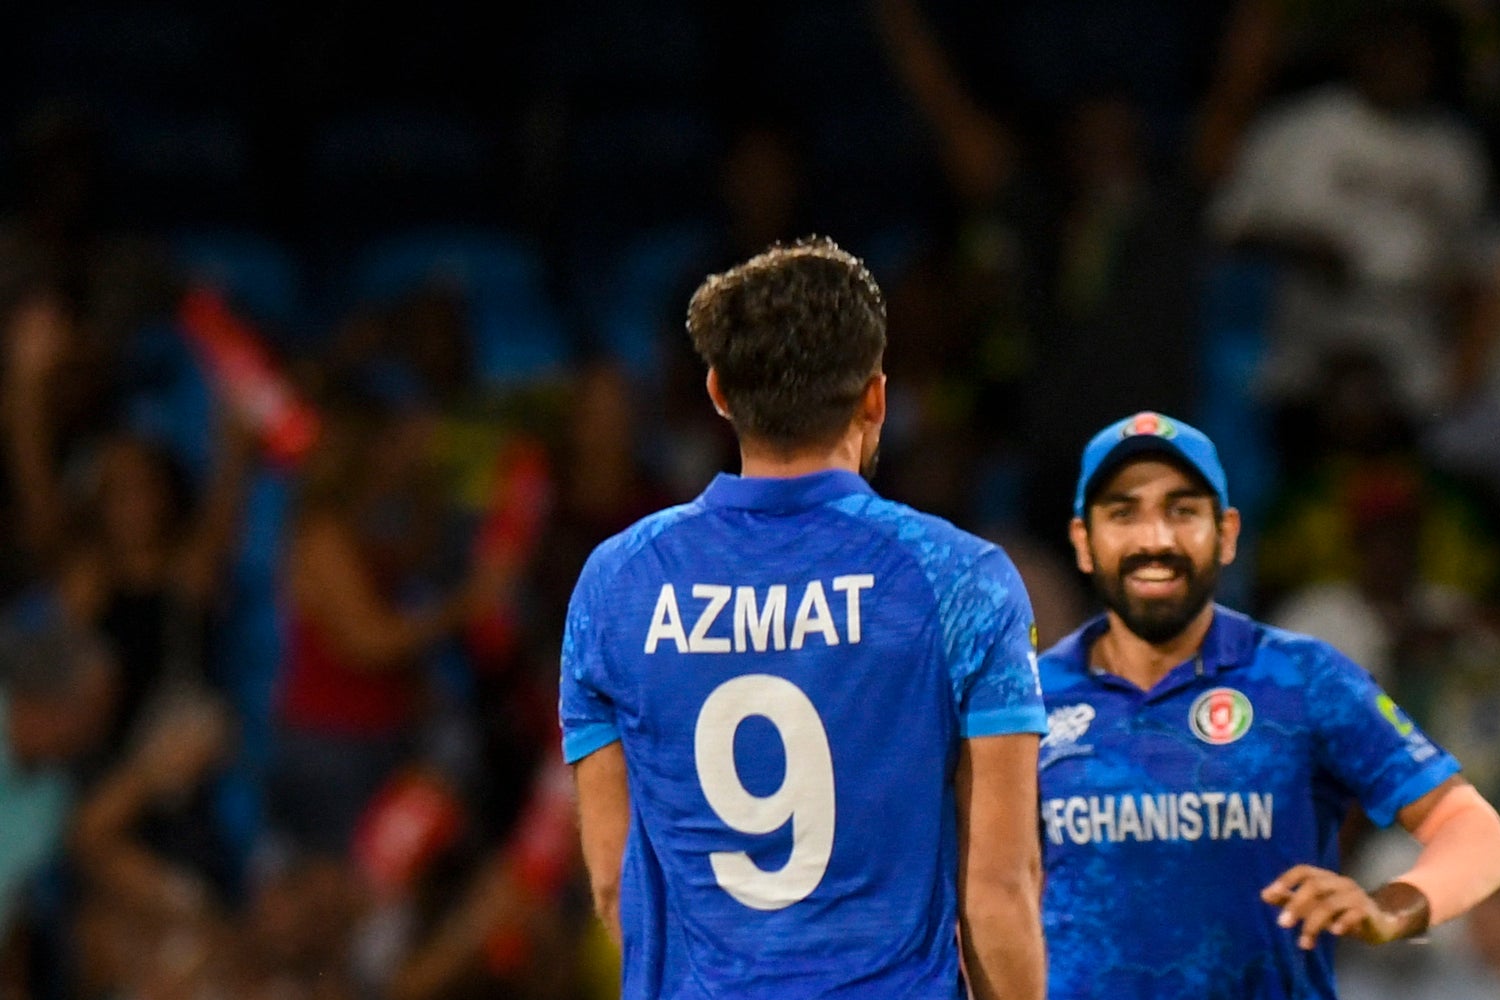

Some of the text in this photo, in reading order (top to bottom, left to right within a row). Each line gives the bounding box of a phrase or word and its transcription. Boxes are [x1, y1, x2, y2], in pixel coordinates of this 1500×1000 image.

[644, 573, 875, 655] AZMAT
[694, 673, 836, 911] 9
[1042, 791, 1273, 845] FGHANISTAN
